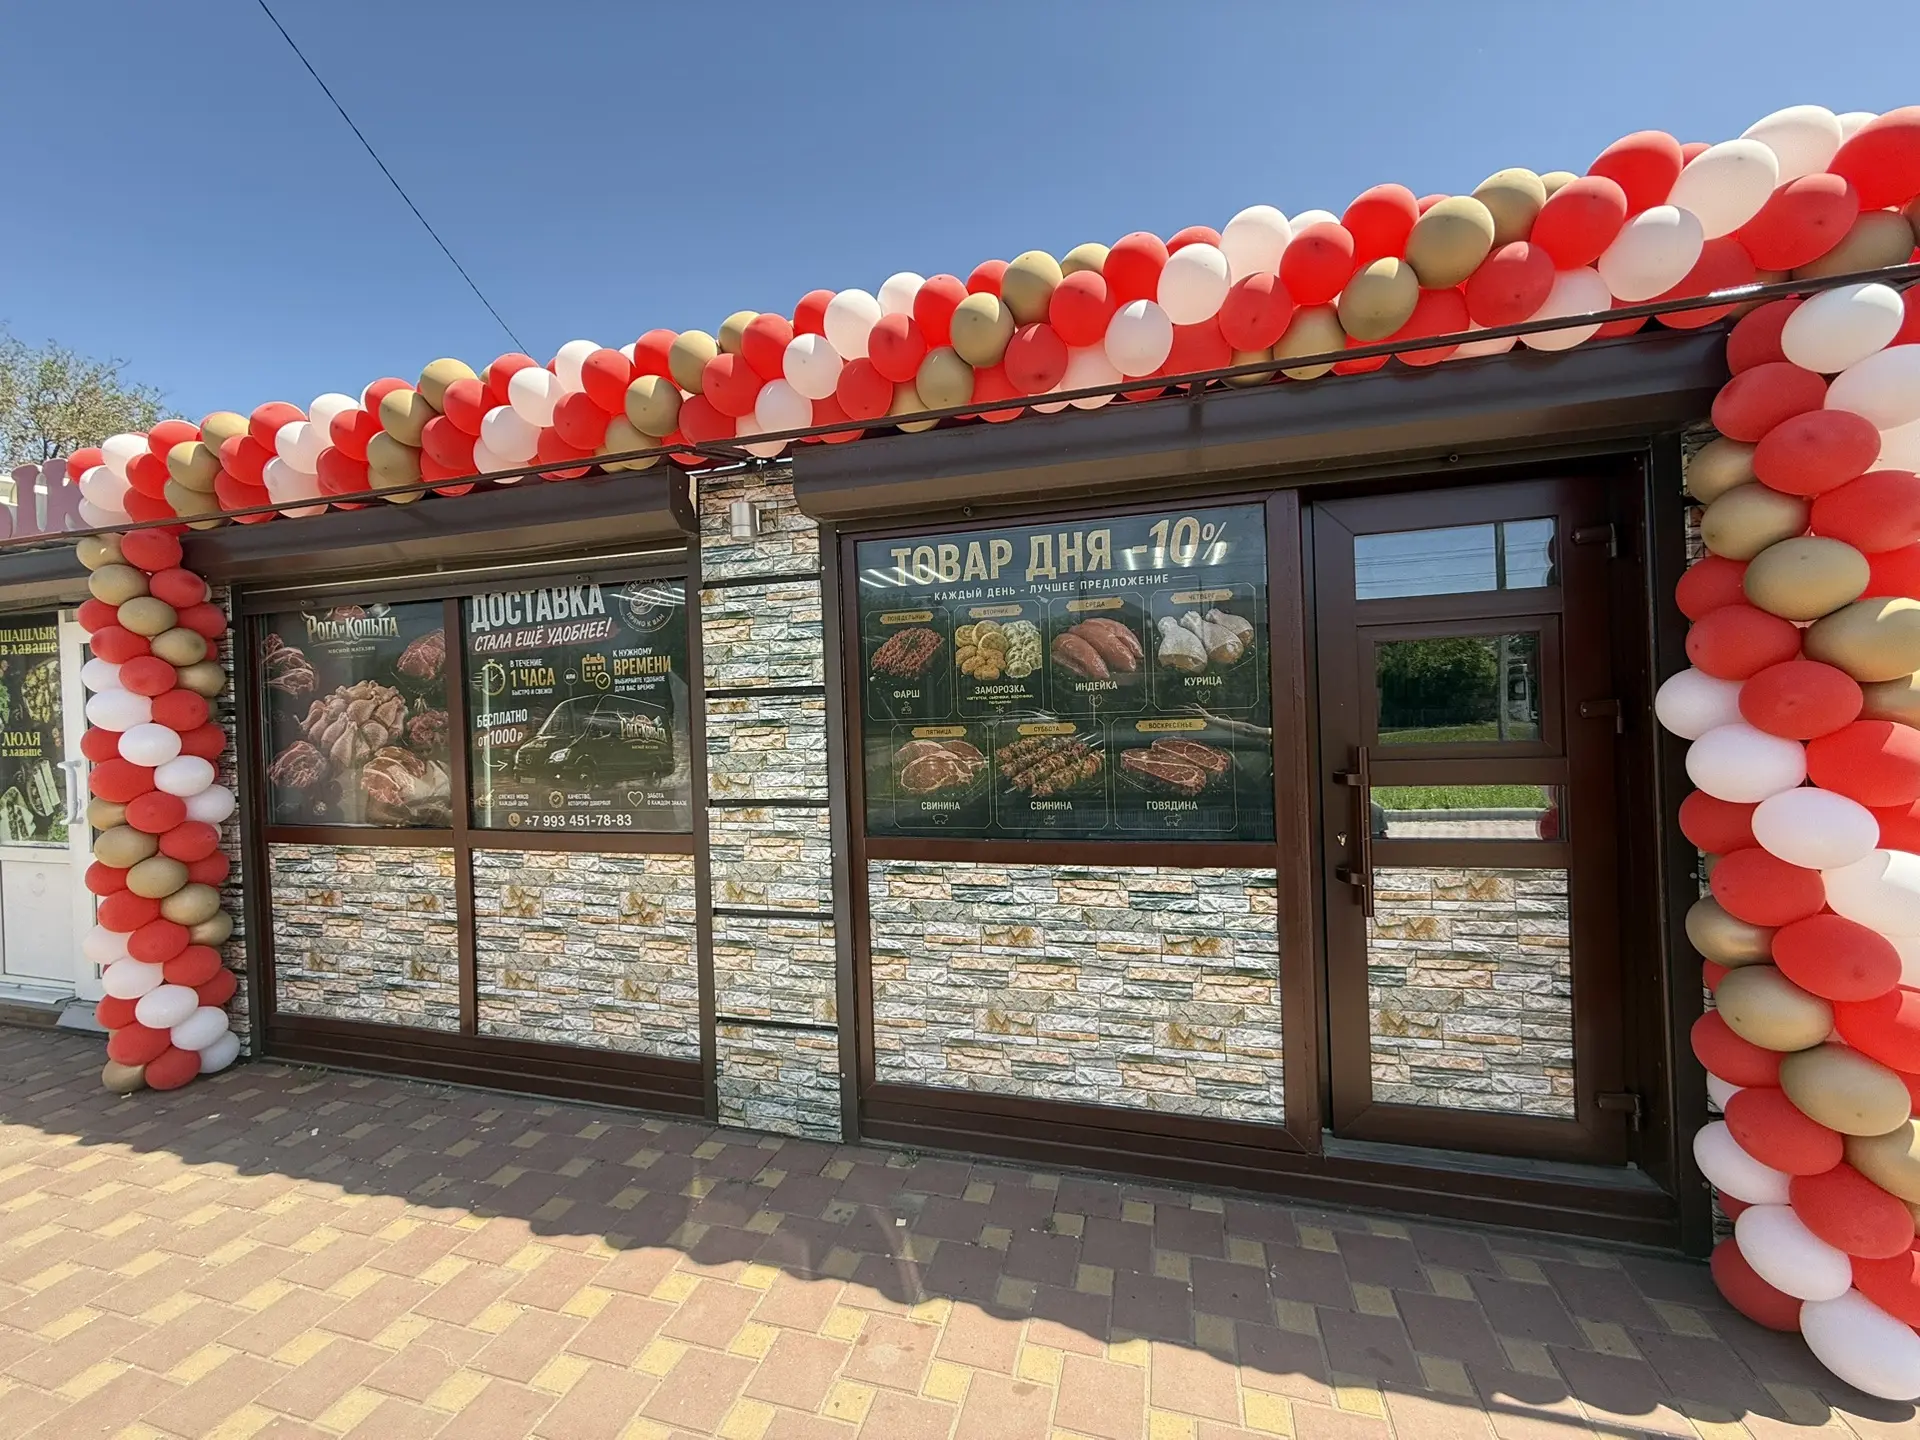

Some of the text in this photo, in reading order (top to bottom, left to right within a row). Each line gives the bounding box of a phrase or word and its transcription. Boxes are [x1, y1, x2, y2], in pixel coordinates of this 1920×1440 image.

[891, 516, 1228, 587] ТОВАР ДНЯ -10%
[934, 588, 982, 601] КАЖДЫЙ
[987, 588, 1016, 599] ДЕНЬ
[1029, 580, 1075, 594] ЛУЧШЕЕ
[1080, 573, 1169, 590] ПРЕДЛОЖЕНИЕ
[1188, 593, 1216, 601] ЧЕТВЕРГ
[471, 584, 606, 632] ДОСТАВКА
[0, 626, 57, 643] ШАШЛЫК
[474, 617, 612, 652] СТАЛА ЕЩЁ УДОБНЕЕ!
[10, 642, 58, 655] лаваше
[613, 647, 653, 658] К НУЖНОМУ
[509, 659, 543, 668] В ТЕЧЕНИЕ
[613, 655, 671, 676] ВРЕМЕНИ
[510, 667, 556, 688] 1 ЧАСА
[1184, 676, 1223, 687] КУРИЦА
[974, 684, 1026, 695] ЗАМОРОЗКА
[1075, 680, 1118, 691] ИНДЕЙКА
[893, 689, 920, 699] ФАРШ
[476, 708, 528, 728] БЕСПЛАТНО
[1148, 721, 1193, 729] ВОСКРЕСЕНЬЕ
[2, 731, 41, 747] ЛЮЛЯ
[9, 747, 43, 757] лаваше
[921, 801, 960, 811] СВИНИНА
[1030, 801, 1073, 811] СВИНИНА
[1146, 800, 1199, 811] ГОВЯДИНА
[525, 814, 632, 827] +7 993 451-78-83
